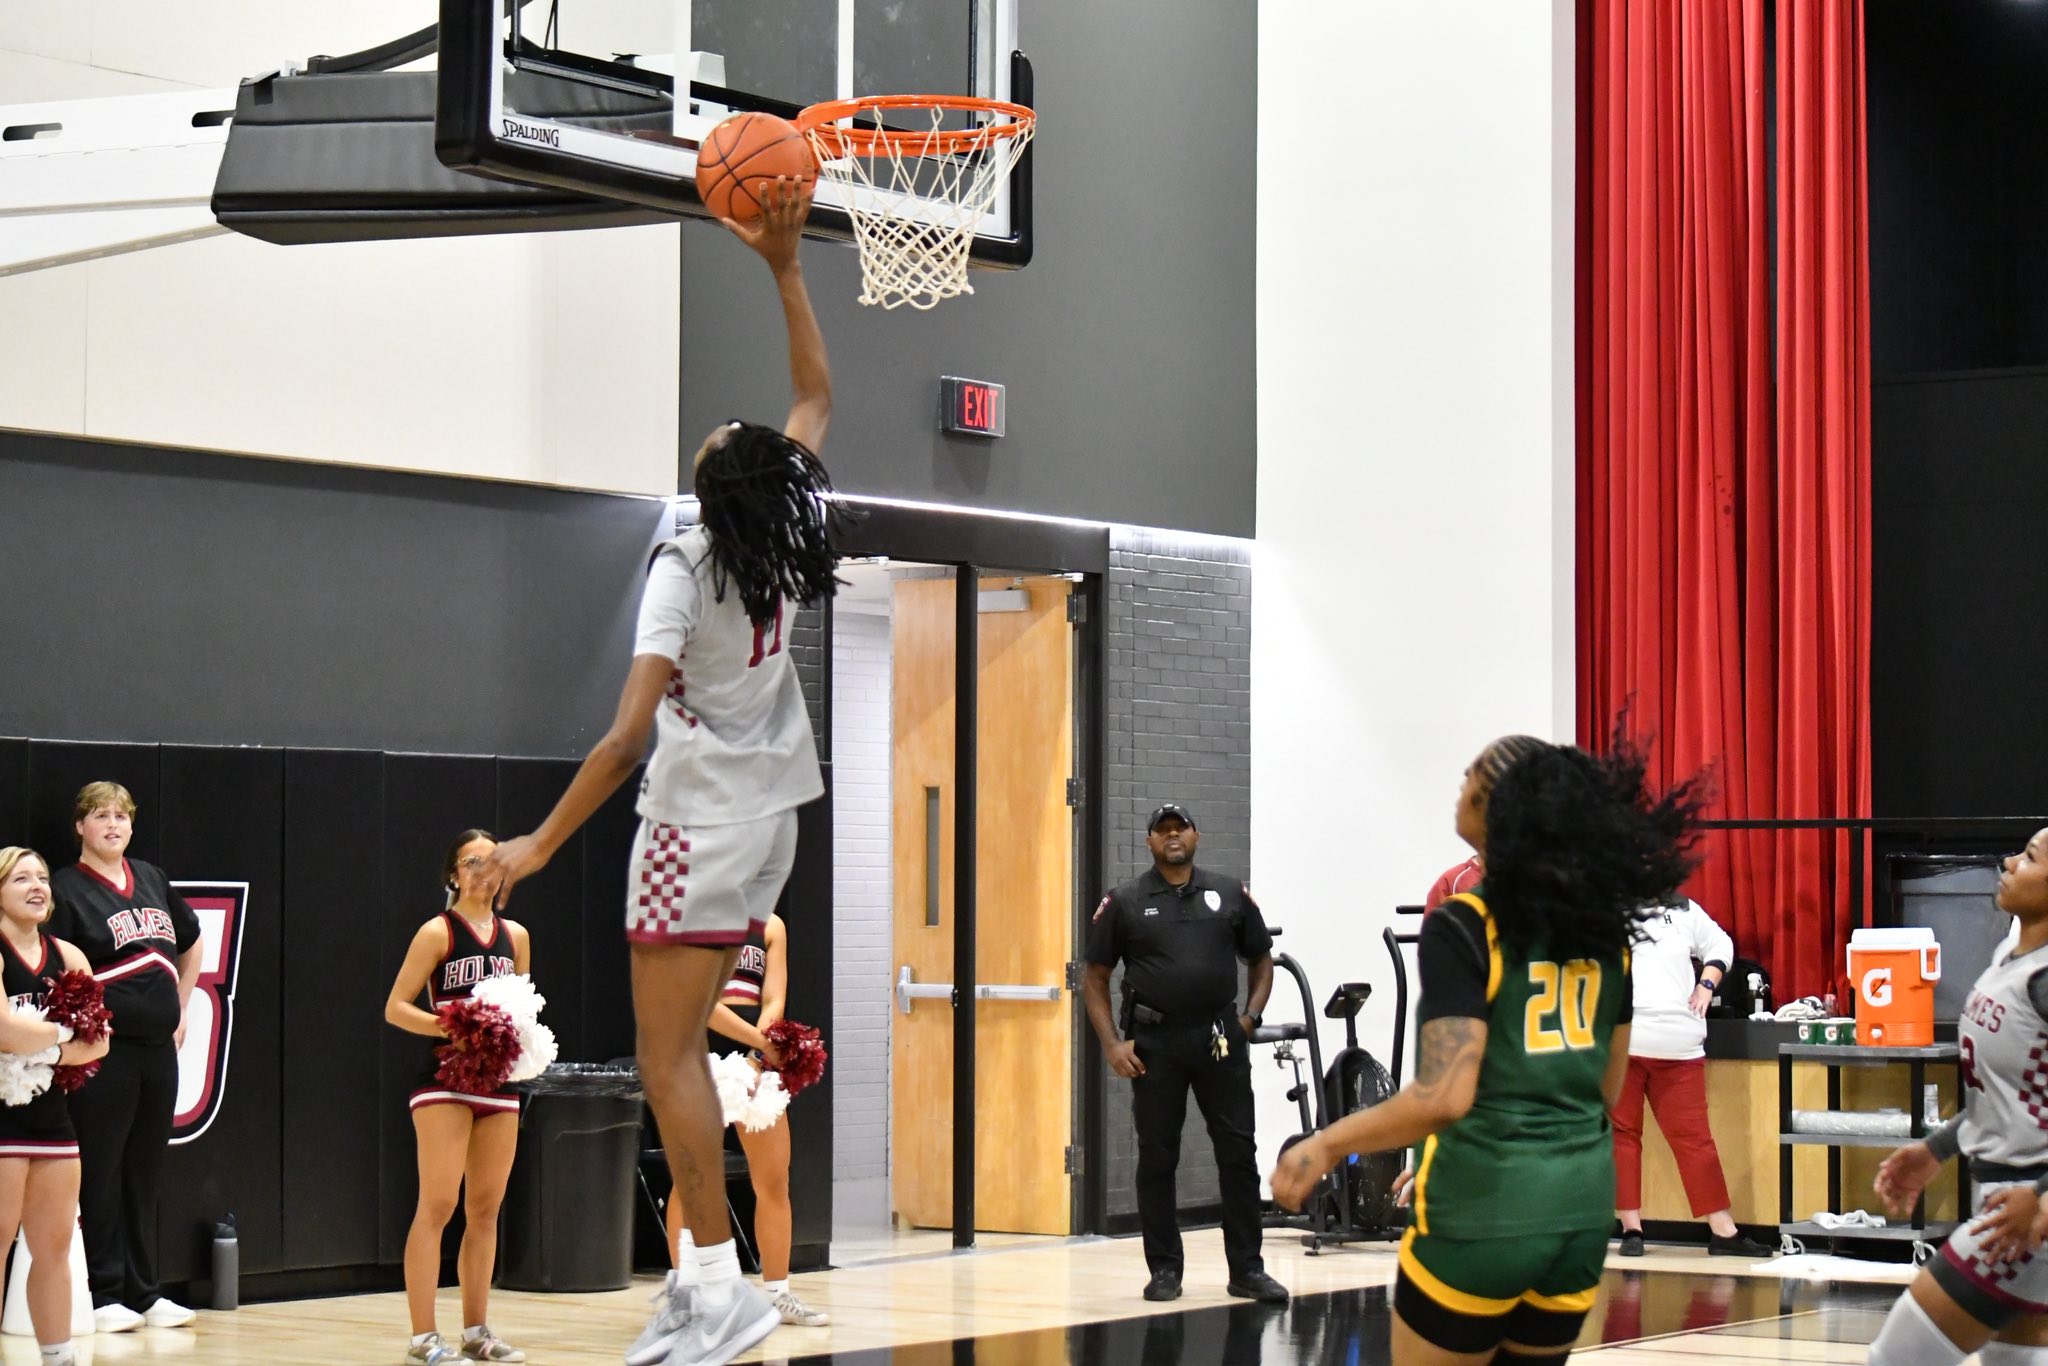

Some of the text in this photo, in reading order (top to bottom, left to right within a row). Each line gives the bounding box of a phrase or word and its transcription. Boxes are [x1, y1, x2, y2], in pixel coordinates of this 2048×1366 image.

[502, 118, 559, 148] SPALDING
[964, 385, 998, 430] EXIT
[106, 907, 177, 951] HOLMES
[1663, 914, 1673, 925] H
[1524, 958, 1602, 1055] 20
[1861, 967, 1893, 1008] G
